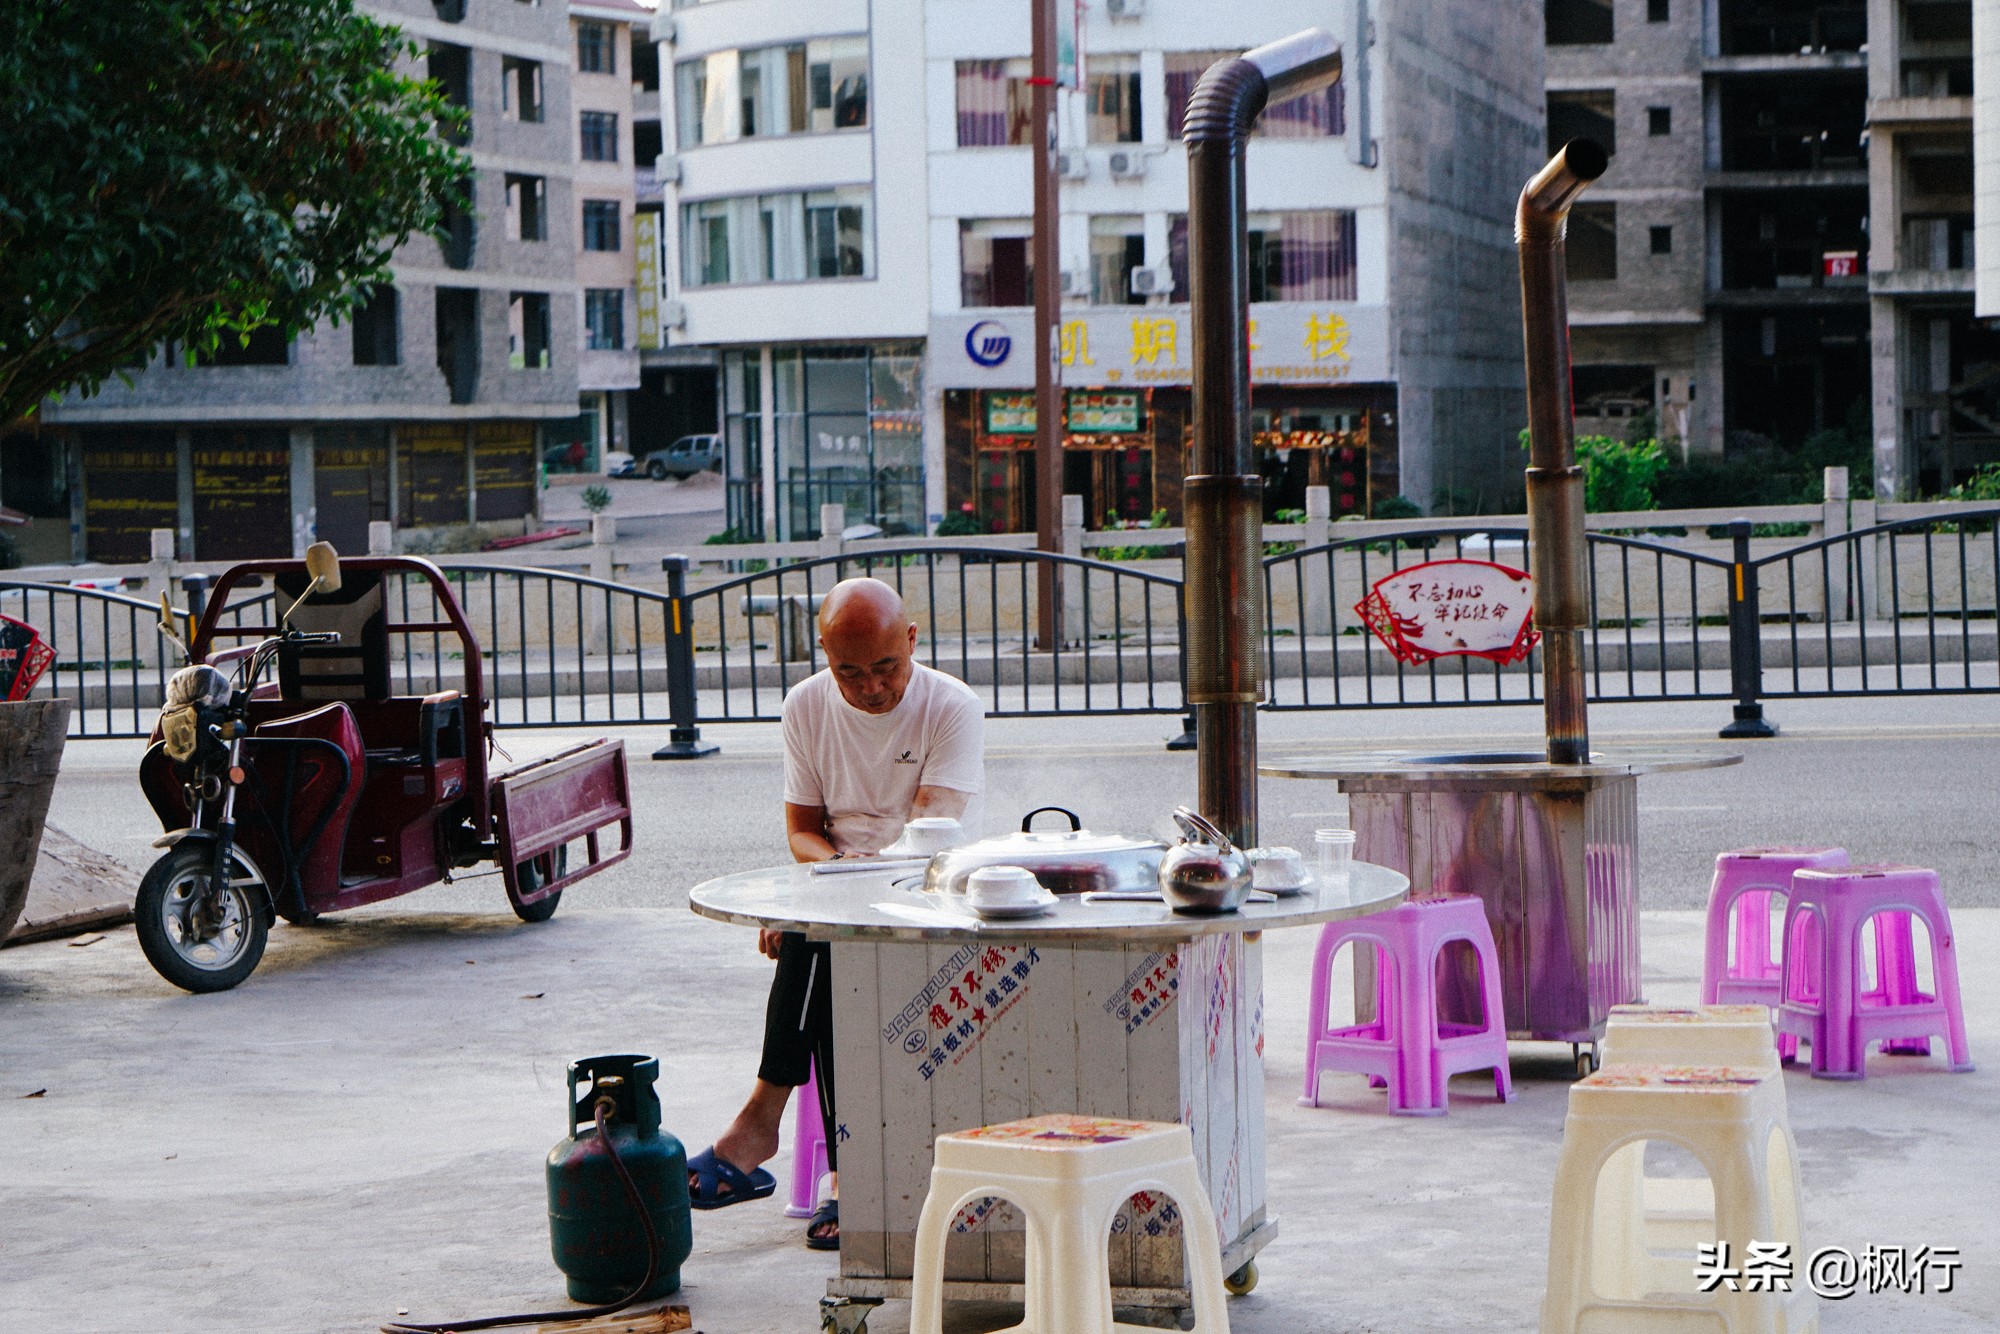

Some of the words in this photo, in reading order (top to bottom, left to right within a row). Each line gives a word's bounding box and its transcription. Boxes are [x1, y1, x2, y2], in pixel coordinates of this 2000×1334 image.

[1408, 582, 1484, 602] 不忘初心
[1434, 603, 1509, 622] 牢记使命
[929, 945, 1017, 1030] 雅才不锈
[917, 1018, 975, 1081] 正宗板材
[984, 946, 1040, 1008] 就选雅才
[905, 1031, 925, 1051] YC
